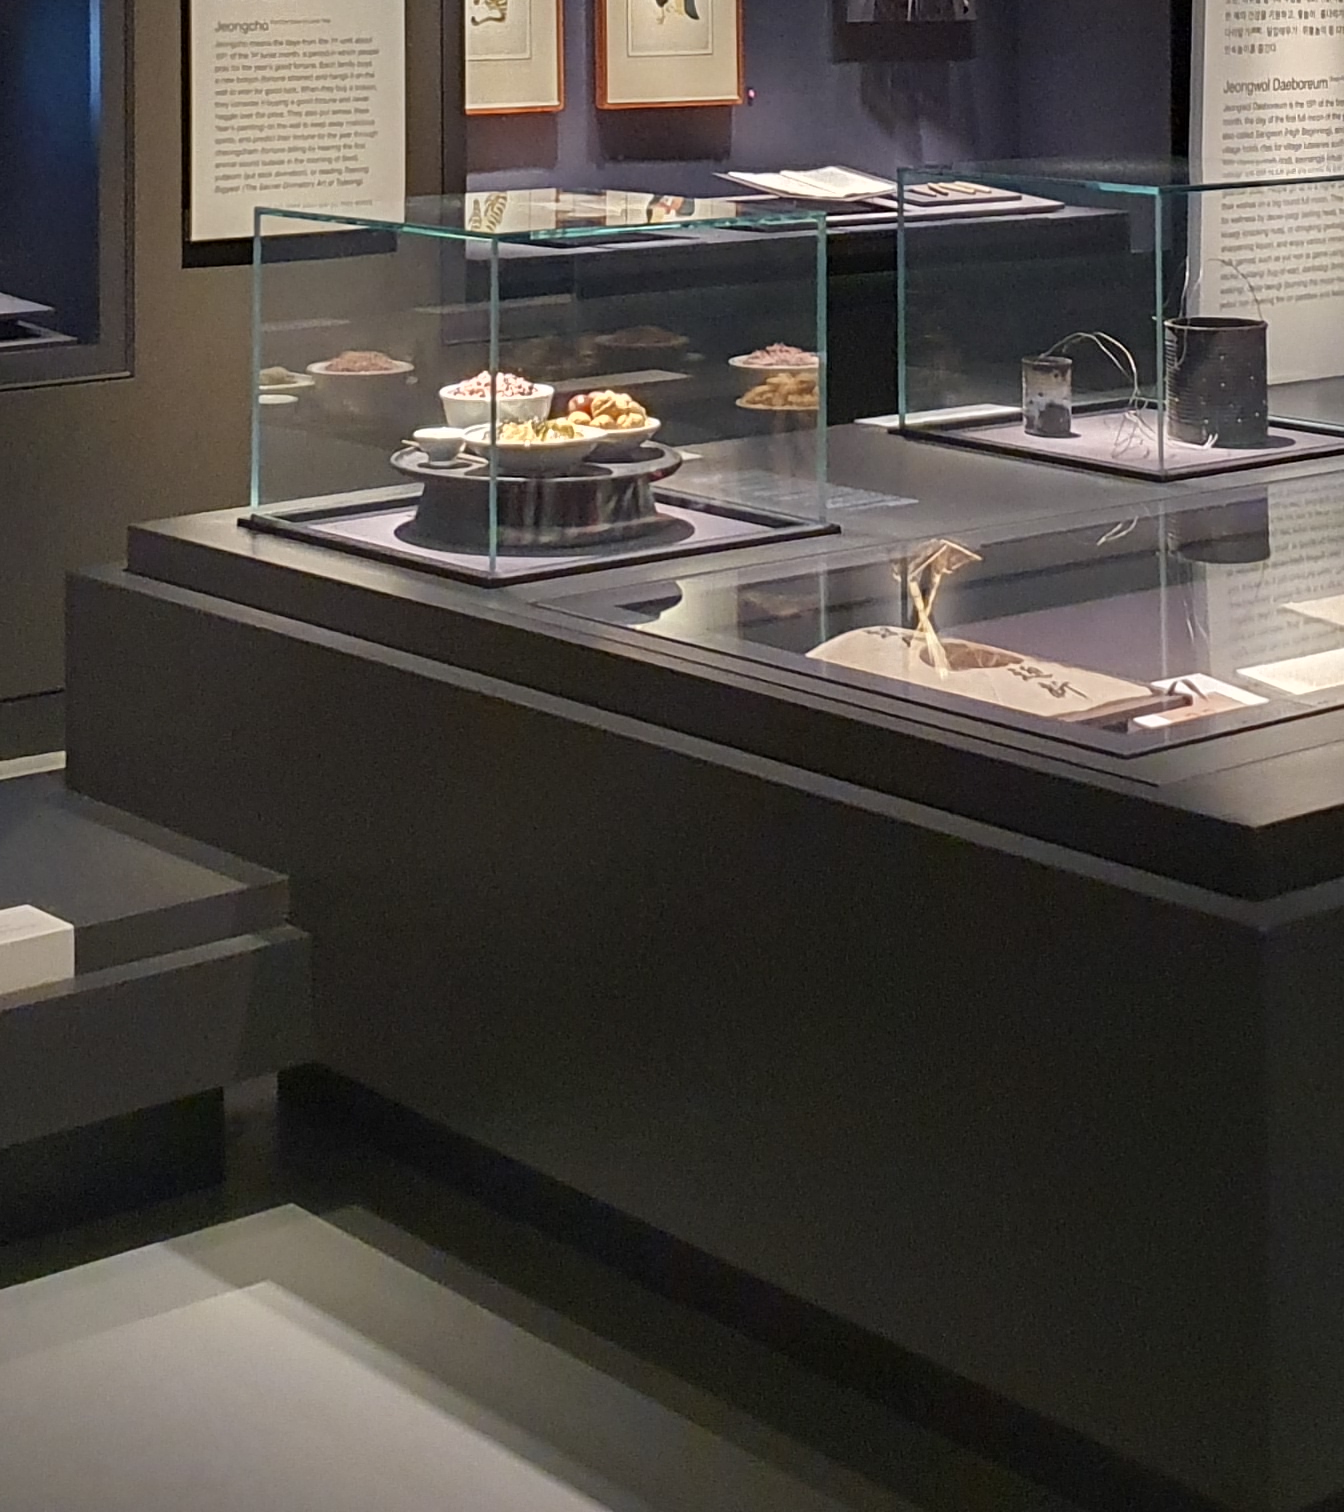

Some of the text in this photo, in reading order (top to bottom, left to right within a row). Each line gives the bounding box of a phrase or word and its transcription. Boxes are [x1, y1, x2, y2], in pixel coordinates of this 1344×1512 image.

[215, 21, 269, 34] Jeongcho
[1223, 79, 1270, 96] Jeongwol
[1273, 77, 1328, 91] Daeboreum
